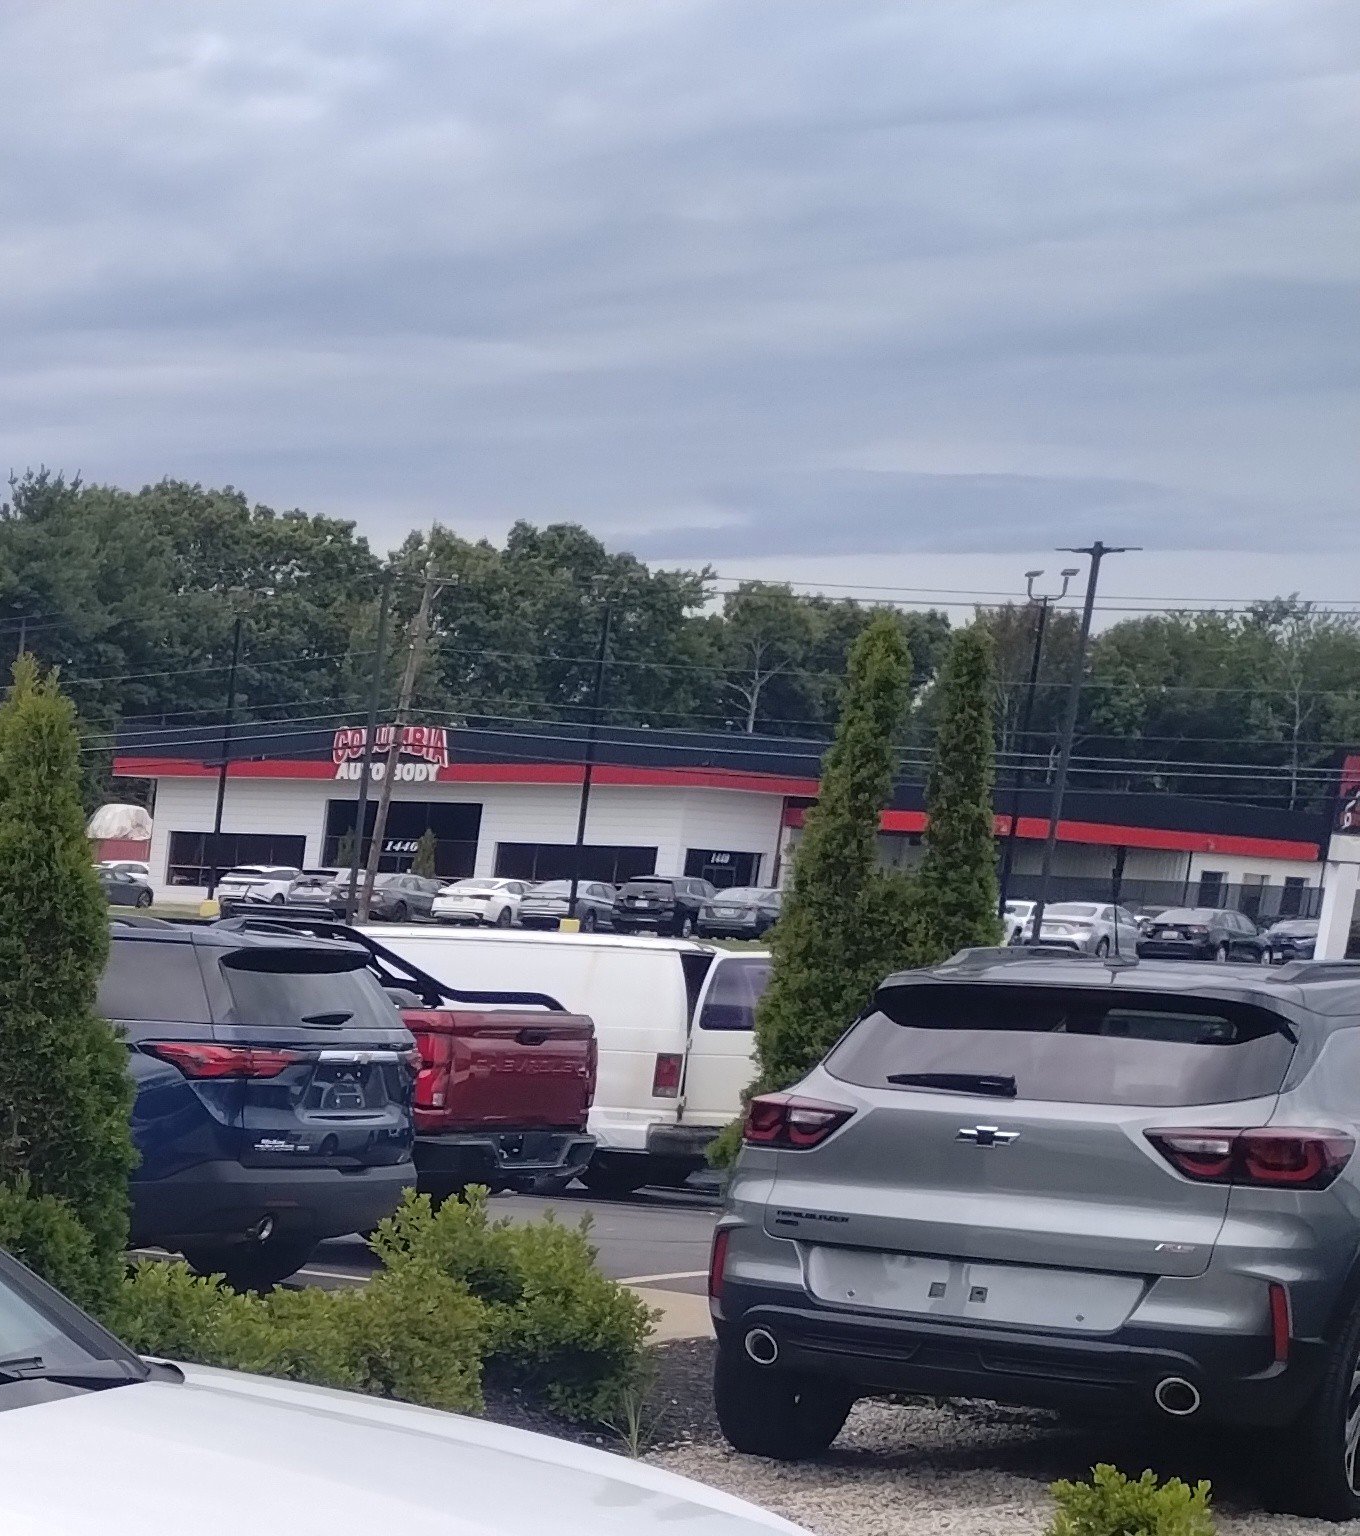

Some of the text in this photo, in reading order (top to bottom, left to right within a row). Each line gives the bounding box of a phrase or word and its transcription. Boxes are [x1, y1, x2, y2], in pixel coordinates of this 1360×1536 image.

[332, 726, 449, 768] COUBIA
[335, 762, 385, 780] AUO
[385, 840, 419, 851] 1440
